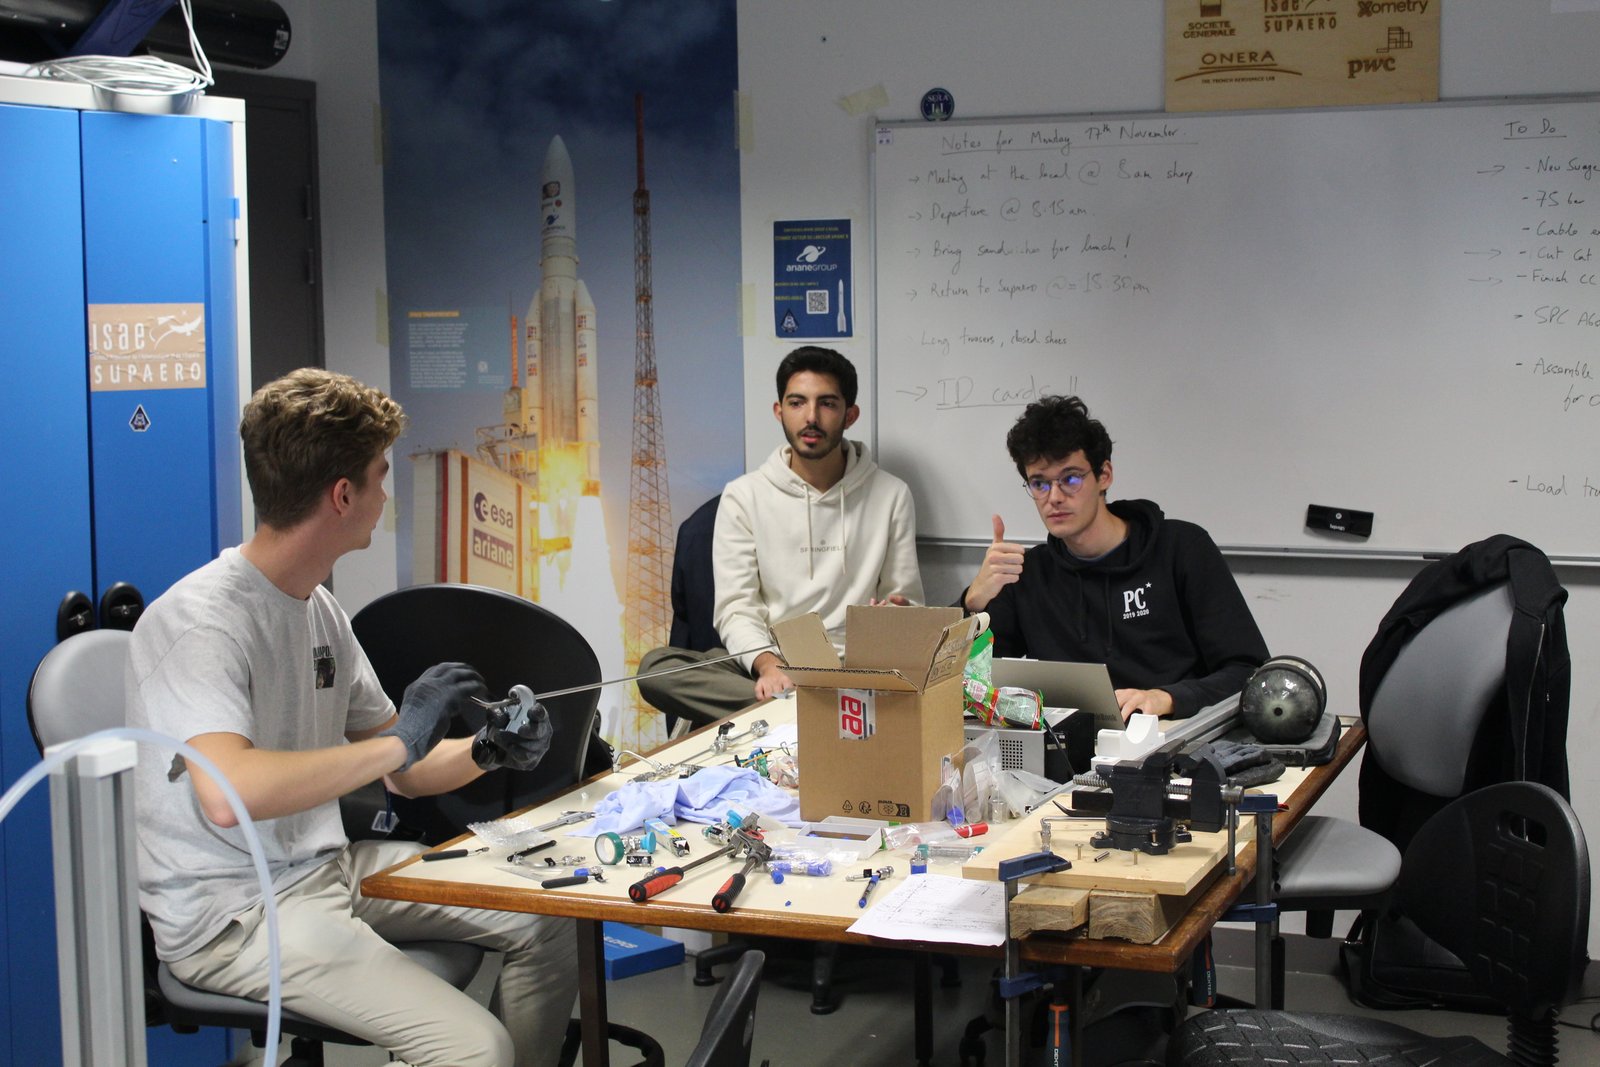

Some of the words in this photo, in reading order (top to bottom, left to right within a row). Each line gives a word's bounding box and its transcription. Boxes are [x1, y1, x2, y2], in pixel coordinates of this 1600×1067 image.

[1183, 28, 1236, 39] GENERALE
[1264, 17, 1337, 33] SUPAERO
[1201, 51, 1275, 65] ONERA
[1348, 57, 1396, 78] pwc
[1504, 121, 1527, 137] To
[1540, 118, 1556, 134] Do
[942, 135, 982, 151] Notes
[996, 131, 1013, 154] for
[1030, 124, 1072, 156] Monday
[1084, 122, 1112, 142] 17th
[1537, 156, 1560, 173] New
[927, 164, 967, 193] Meeting
[980, 164, 997, 181] at
[1009, 163, 1031, 181] the
[1038, 162, 1072, 181] local
[1079, 160, 1101, 185] @
[1536, 190, 1559, 207] 75
[930, 201, 989, 226] Departure
[1000, 197, 1022, 222] @
[1536, 221, 1578, 236] Cable
[933, 241, 962, 274] Bring
[1052, 239, 1070, 263] for
[1080, 235, 1116, 255] lunch
[1537, 246, 1564, 260] Cut
[930, 280, 969, 298] Return
[976, 277, 991, 294] to
[1532, 269, 1568, 284] Finish
[921, 331, 950, 355] Long
[1010, 328, 1041, 345] closed
[1044, 330, 1068, 346] shoes
[94, 362, 202, 385] SUPAERO
[1533, 357, 1594, 381] Assemble
[936, 376, 974, 402] ID
[1563, 384, 1585, 412] for
[1526, 474, 1568, 496] Load
[490, 504, 514, 529] esa
[473, 535, 514, 569] ariane
[1123, 587, 1147, 613] PC
[1122, 611, 1136, 620] 2019
[1136, 608, 1150, 617] 2020
